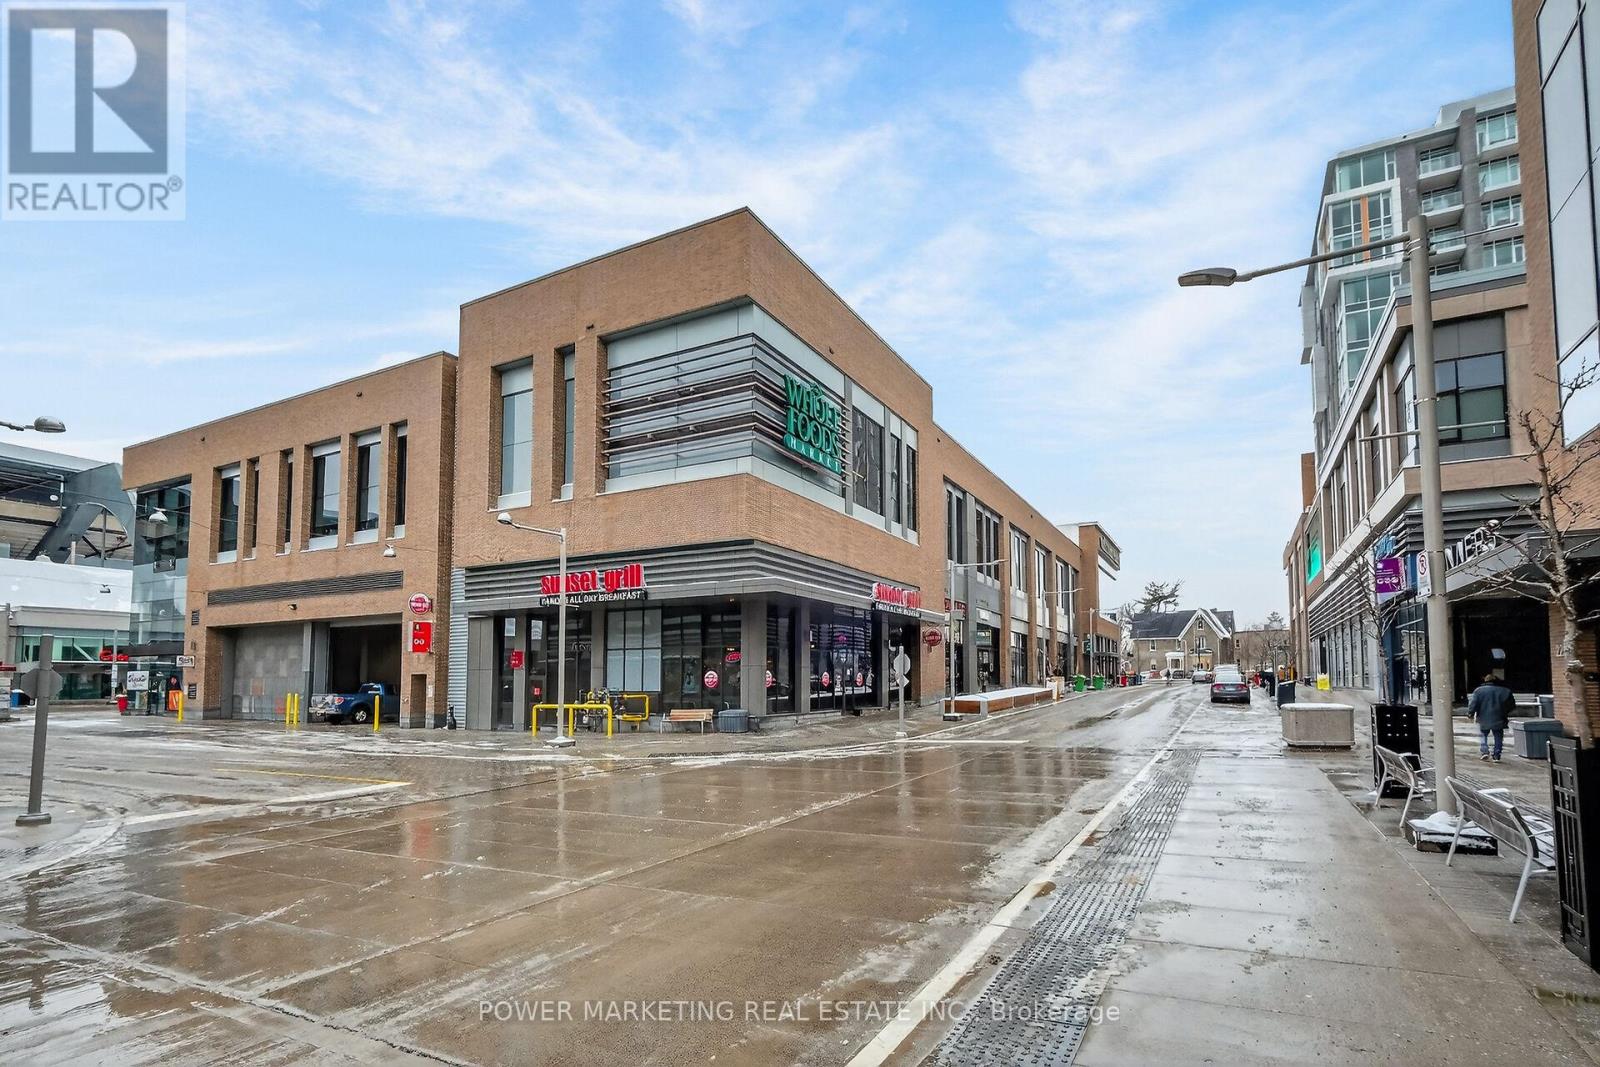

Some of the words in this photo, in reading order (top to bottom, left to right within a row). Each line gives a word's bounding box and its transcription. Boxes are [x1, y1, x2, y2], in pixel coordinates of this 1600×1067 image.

[784, 374, 842, 433] WHOLE
[786, 406, 842, 460] FOODS
[600, 590, 641, 602] BREAKFAST
[604, 563, 644, 592] grill
